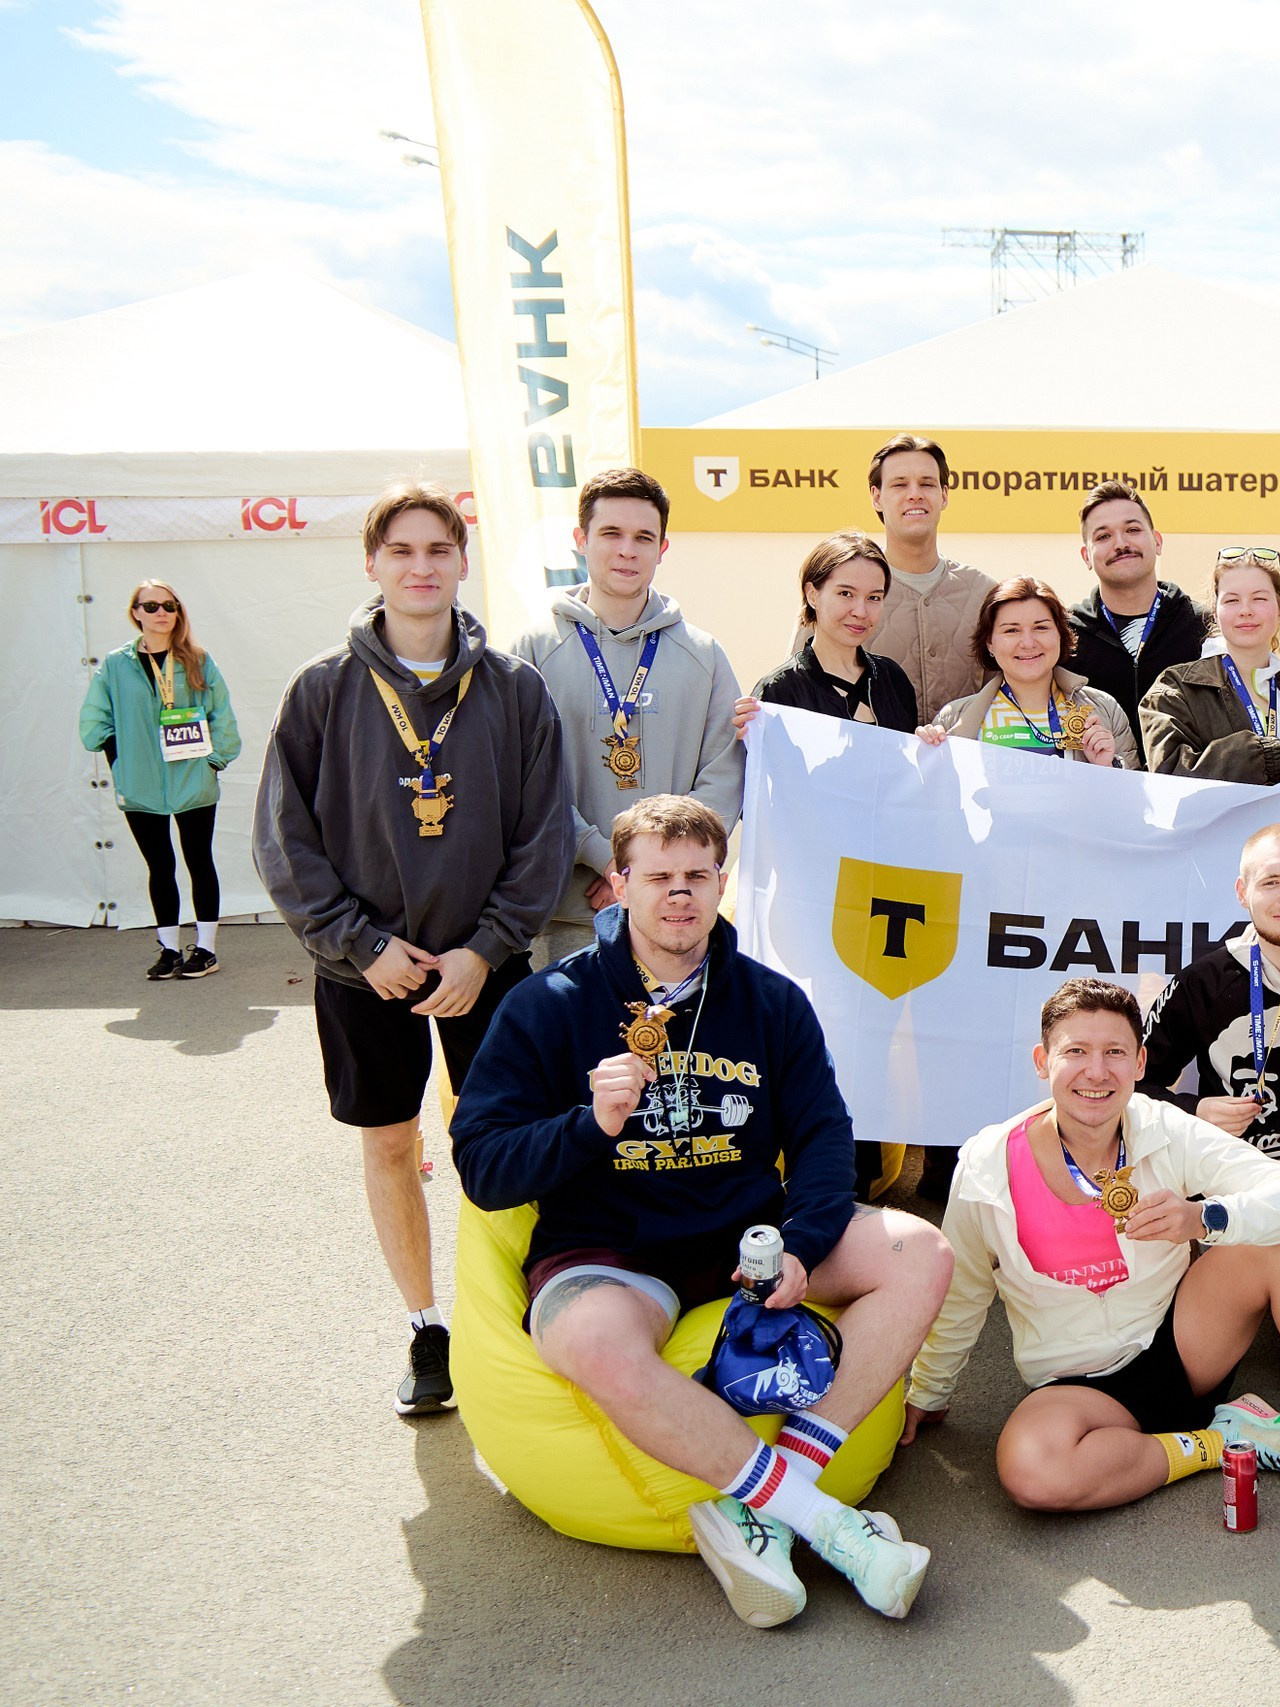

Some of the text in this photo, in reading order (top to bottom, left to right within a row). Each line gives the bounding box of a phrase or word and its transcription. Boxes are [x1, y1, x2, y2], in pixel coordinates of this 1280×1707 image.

[750, 468, 839, 488] БАНК
[947, 467, 1168, 497] рпоративый
[1178, 472, 1278, 498] шатер
[40, 500, 108, 535] ICL
[241, 497, 308, 532] ICL
[630, 672, 645, 696] 10 KM
[391, 703, 409, 732] 10 KM
[437, 724, 447, 736] 10
[166, 725, 201, 742] 42716
[986, 911, 1253, 975] БАНК
[587, 1051, 762, 1091] ERDOG
[613, 1150, 742, 1171] IRON PARADISE
[616, 1133, 736, 1160] GYM
[1039, 1258, 1128, 1280] UNNIN
[1190, 1431, 1208, 1462] БАН
